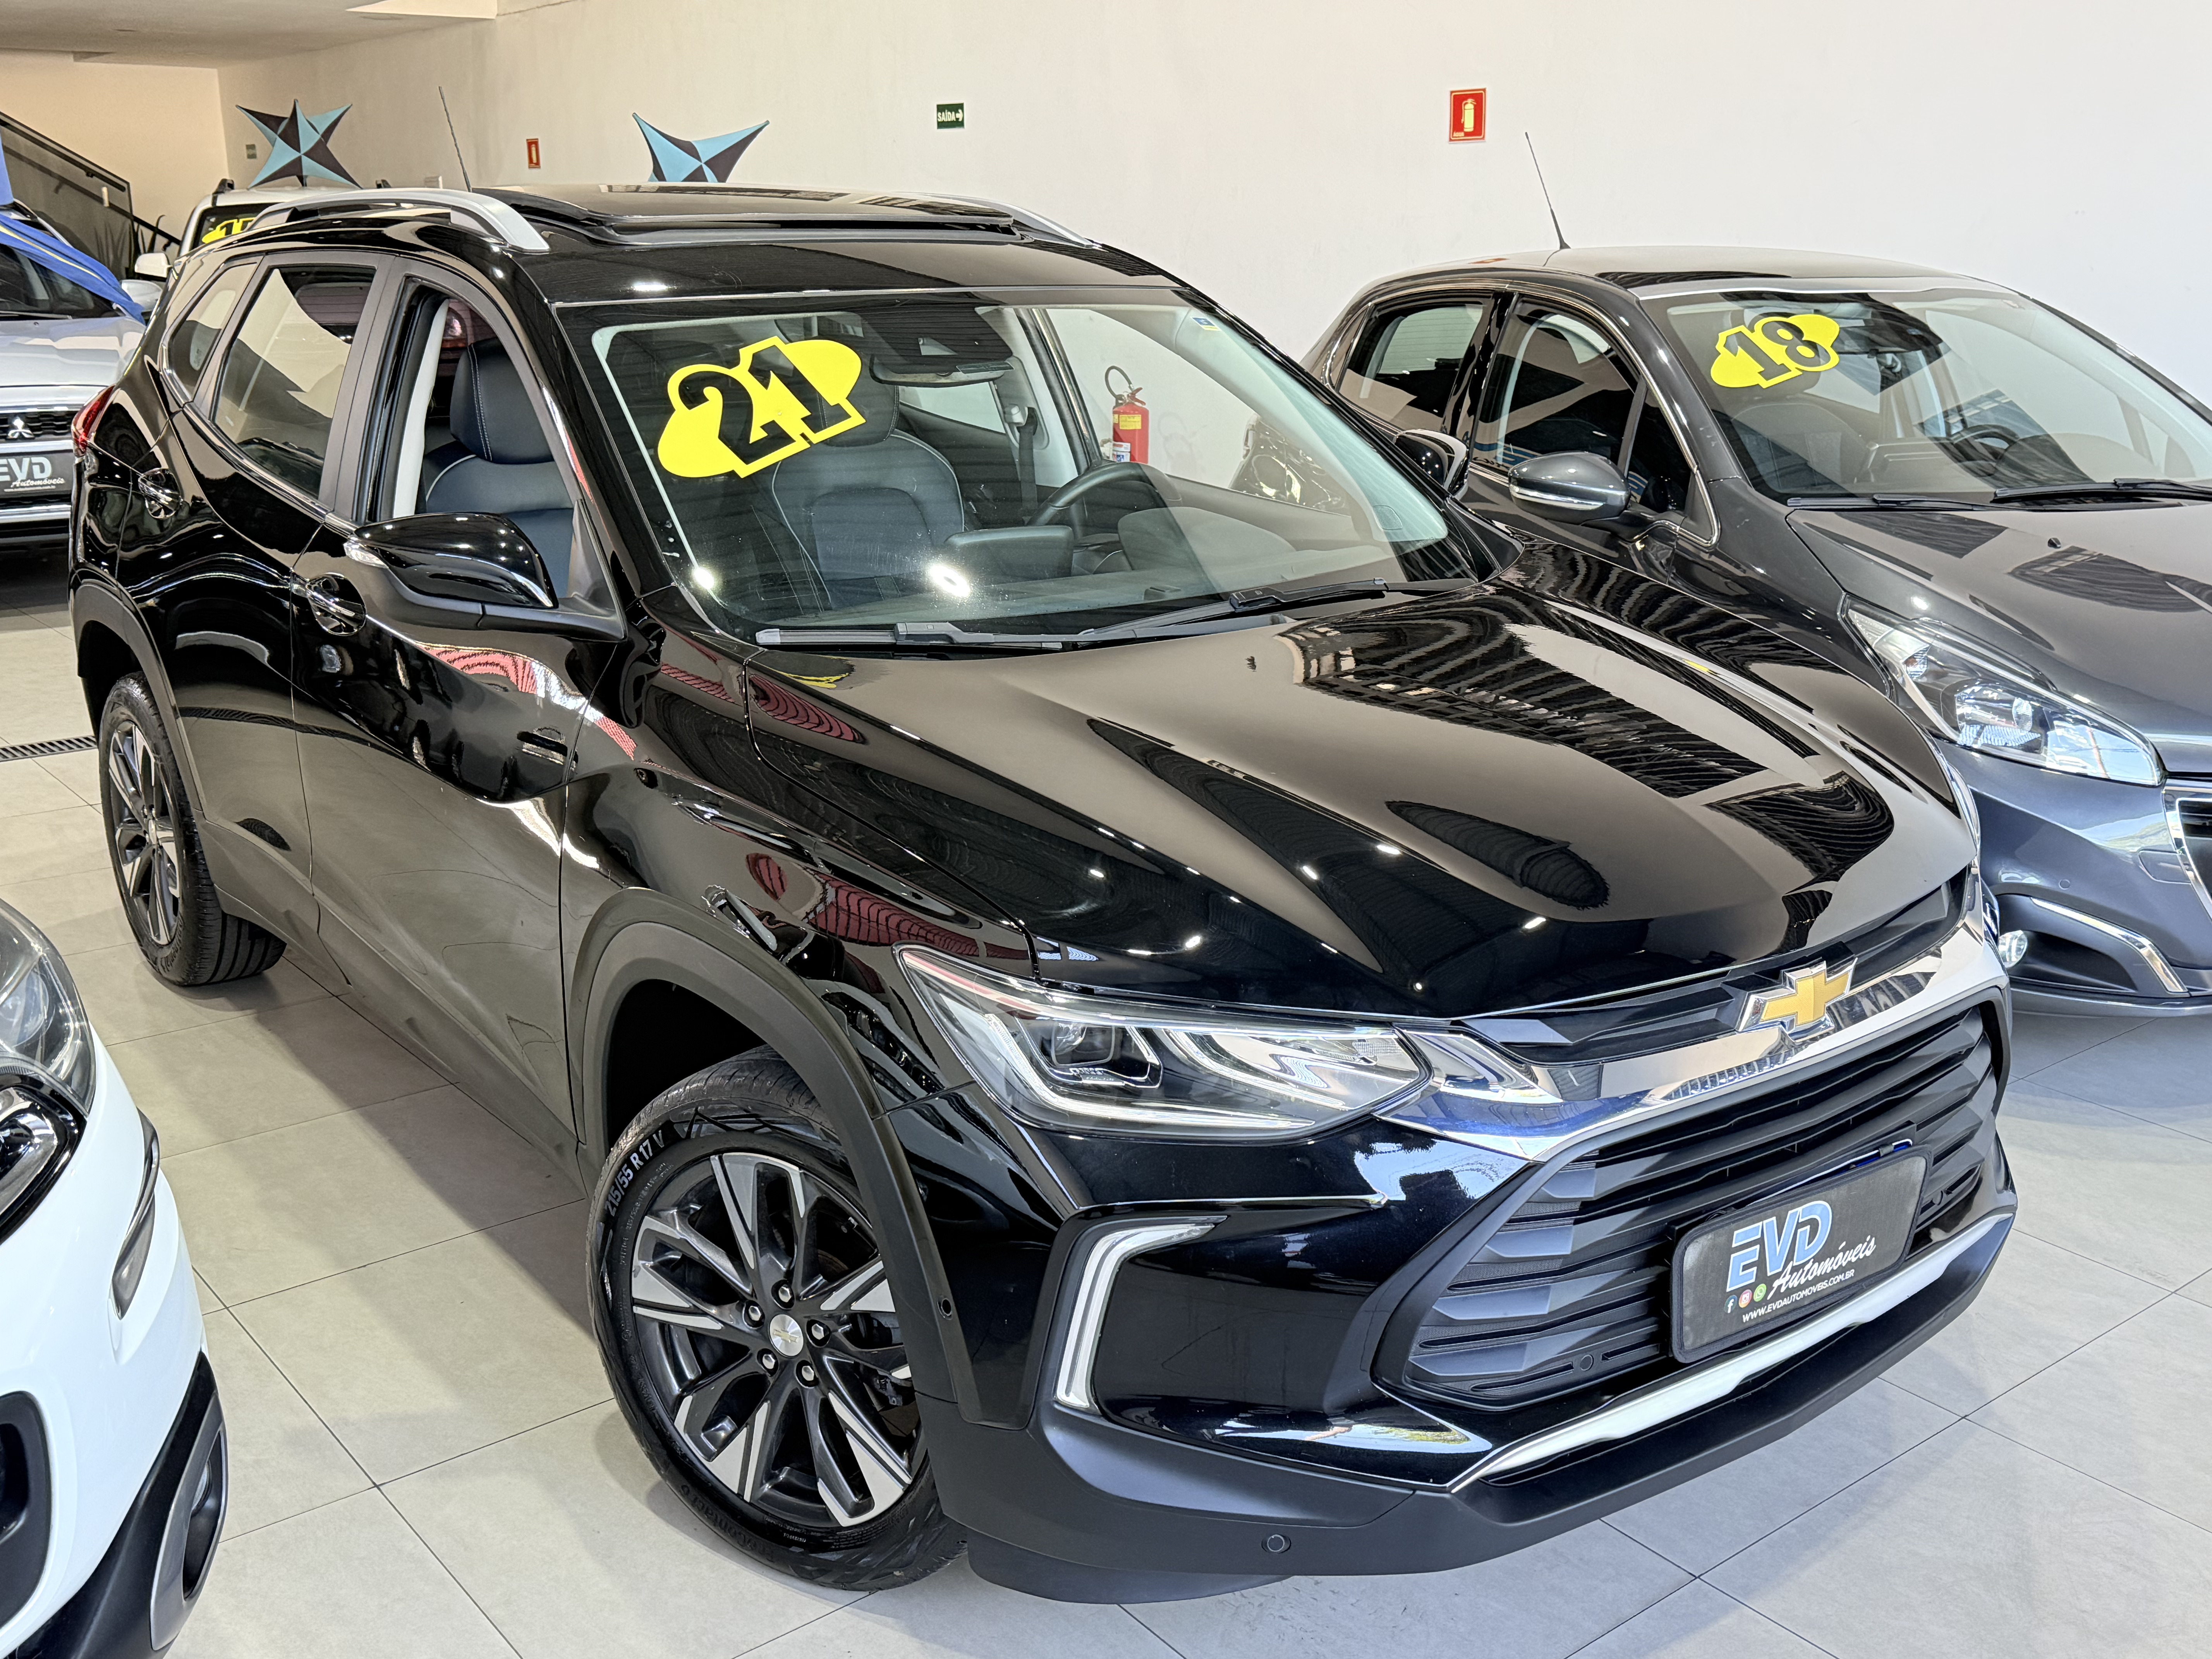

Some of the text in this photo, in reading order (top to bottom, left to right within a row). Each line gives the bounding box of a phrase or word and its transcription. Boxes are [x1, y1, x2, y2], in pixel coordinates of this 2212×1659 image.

[938, 109, 956, 122] SAÍDA
[1723, 320, 1831, 381] 18
[678, 344, 852, 466] 21
[605, 1163, 634, 1217] 215/55
[1726, 1200, 1832, 1292] EVD
[1767, 1235, 1876, 1300] Automóveis
[1742, 1269, 1855, 1323] WWW.EVDAUTOMOVEIS.COM.BR
